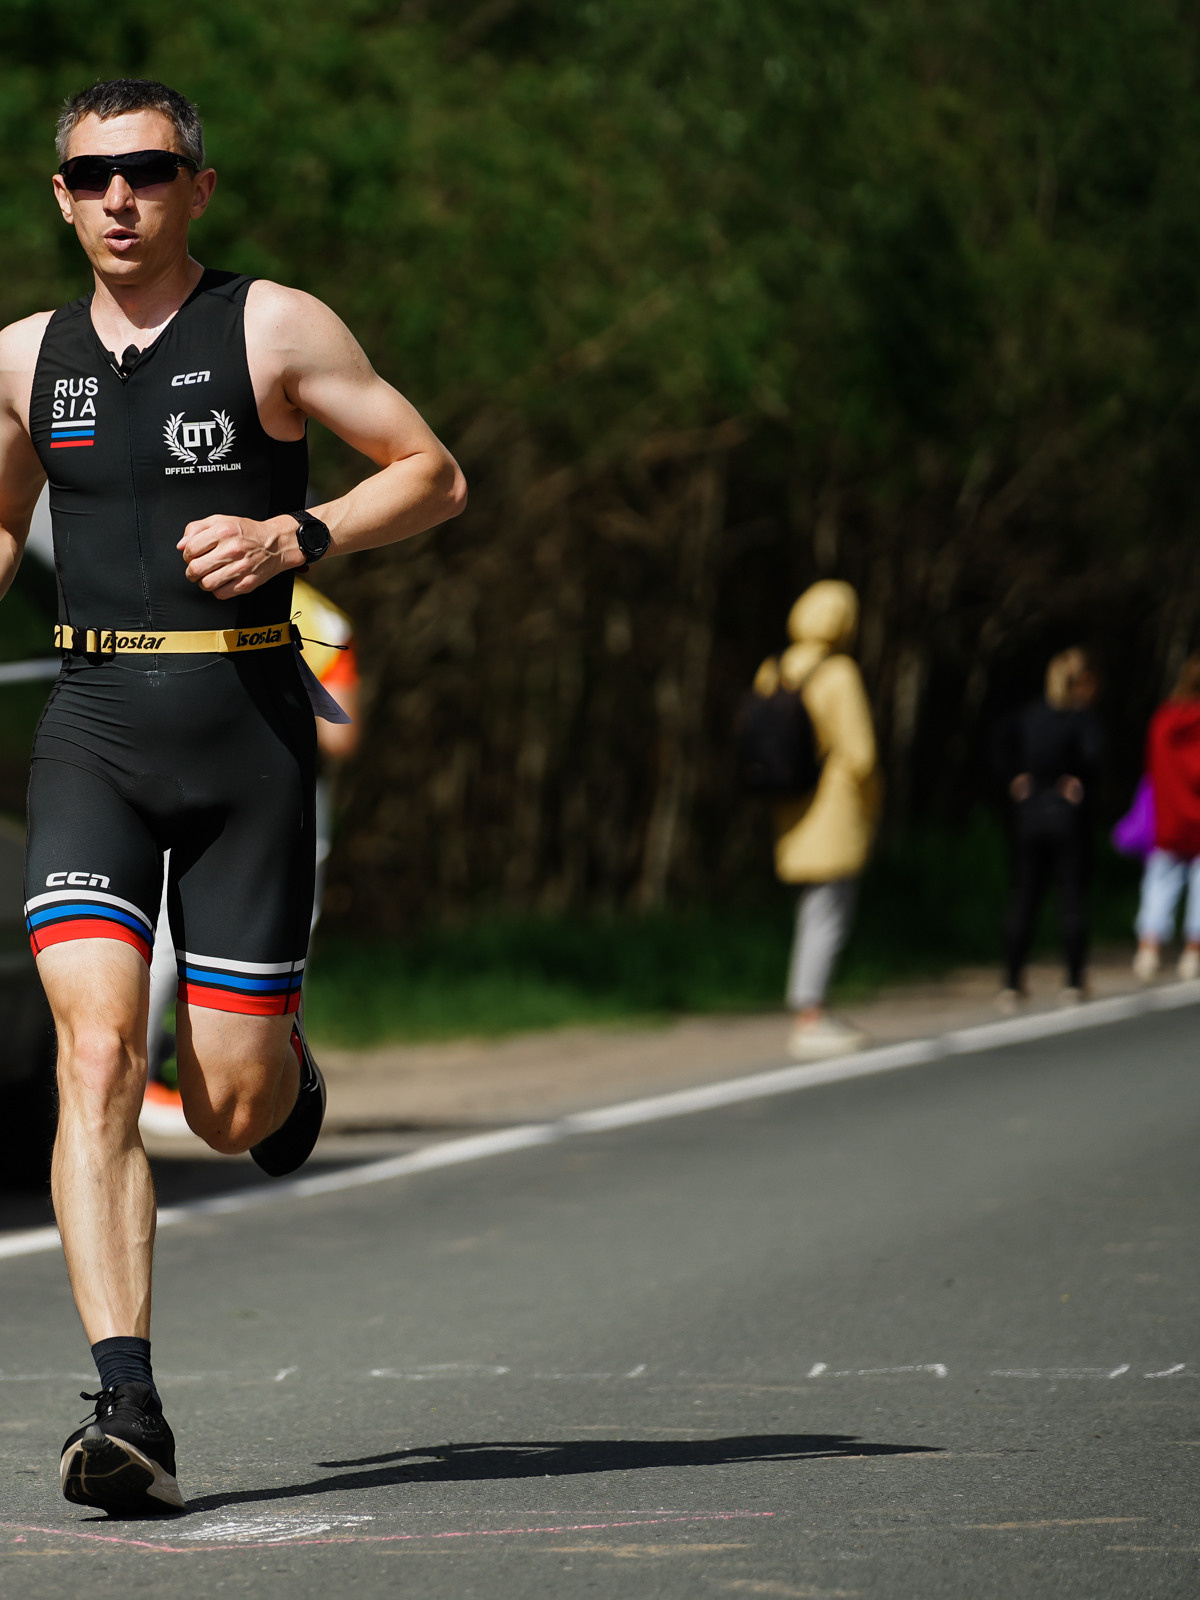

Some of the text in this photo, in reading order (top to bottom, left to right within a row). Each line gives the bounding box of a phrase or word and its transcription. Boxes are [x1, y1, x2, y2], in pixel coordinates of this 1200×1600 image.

[54, 376, 99, 398] RUS
[52, 398, 97, 419] SIA
[182, 420, 217, 448] OT
[165, 462, 242, 475] OFFICE TRIATHLON
[236, 628, 283, 647] isosta
